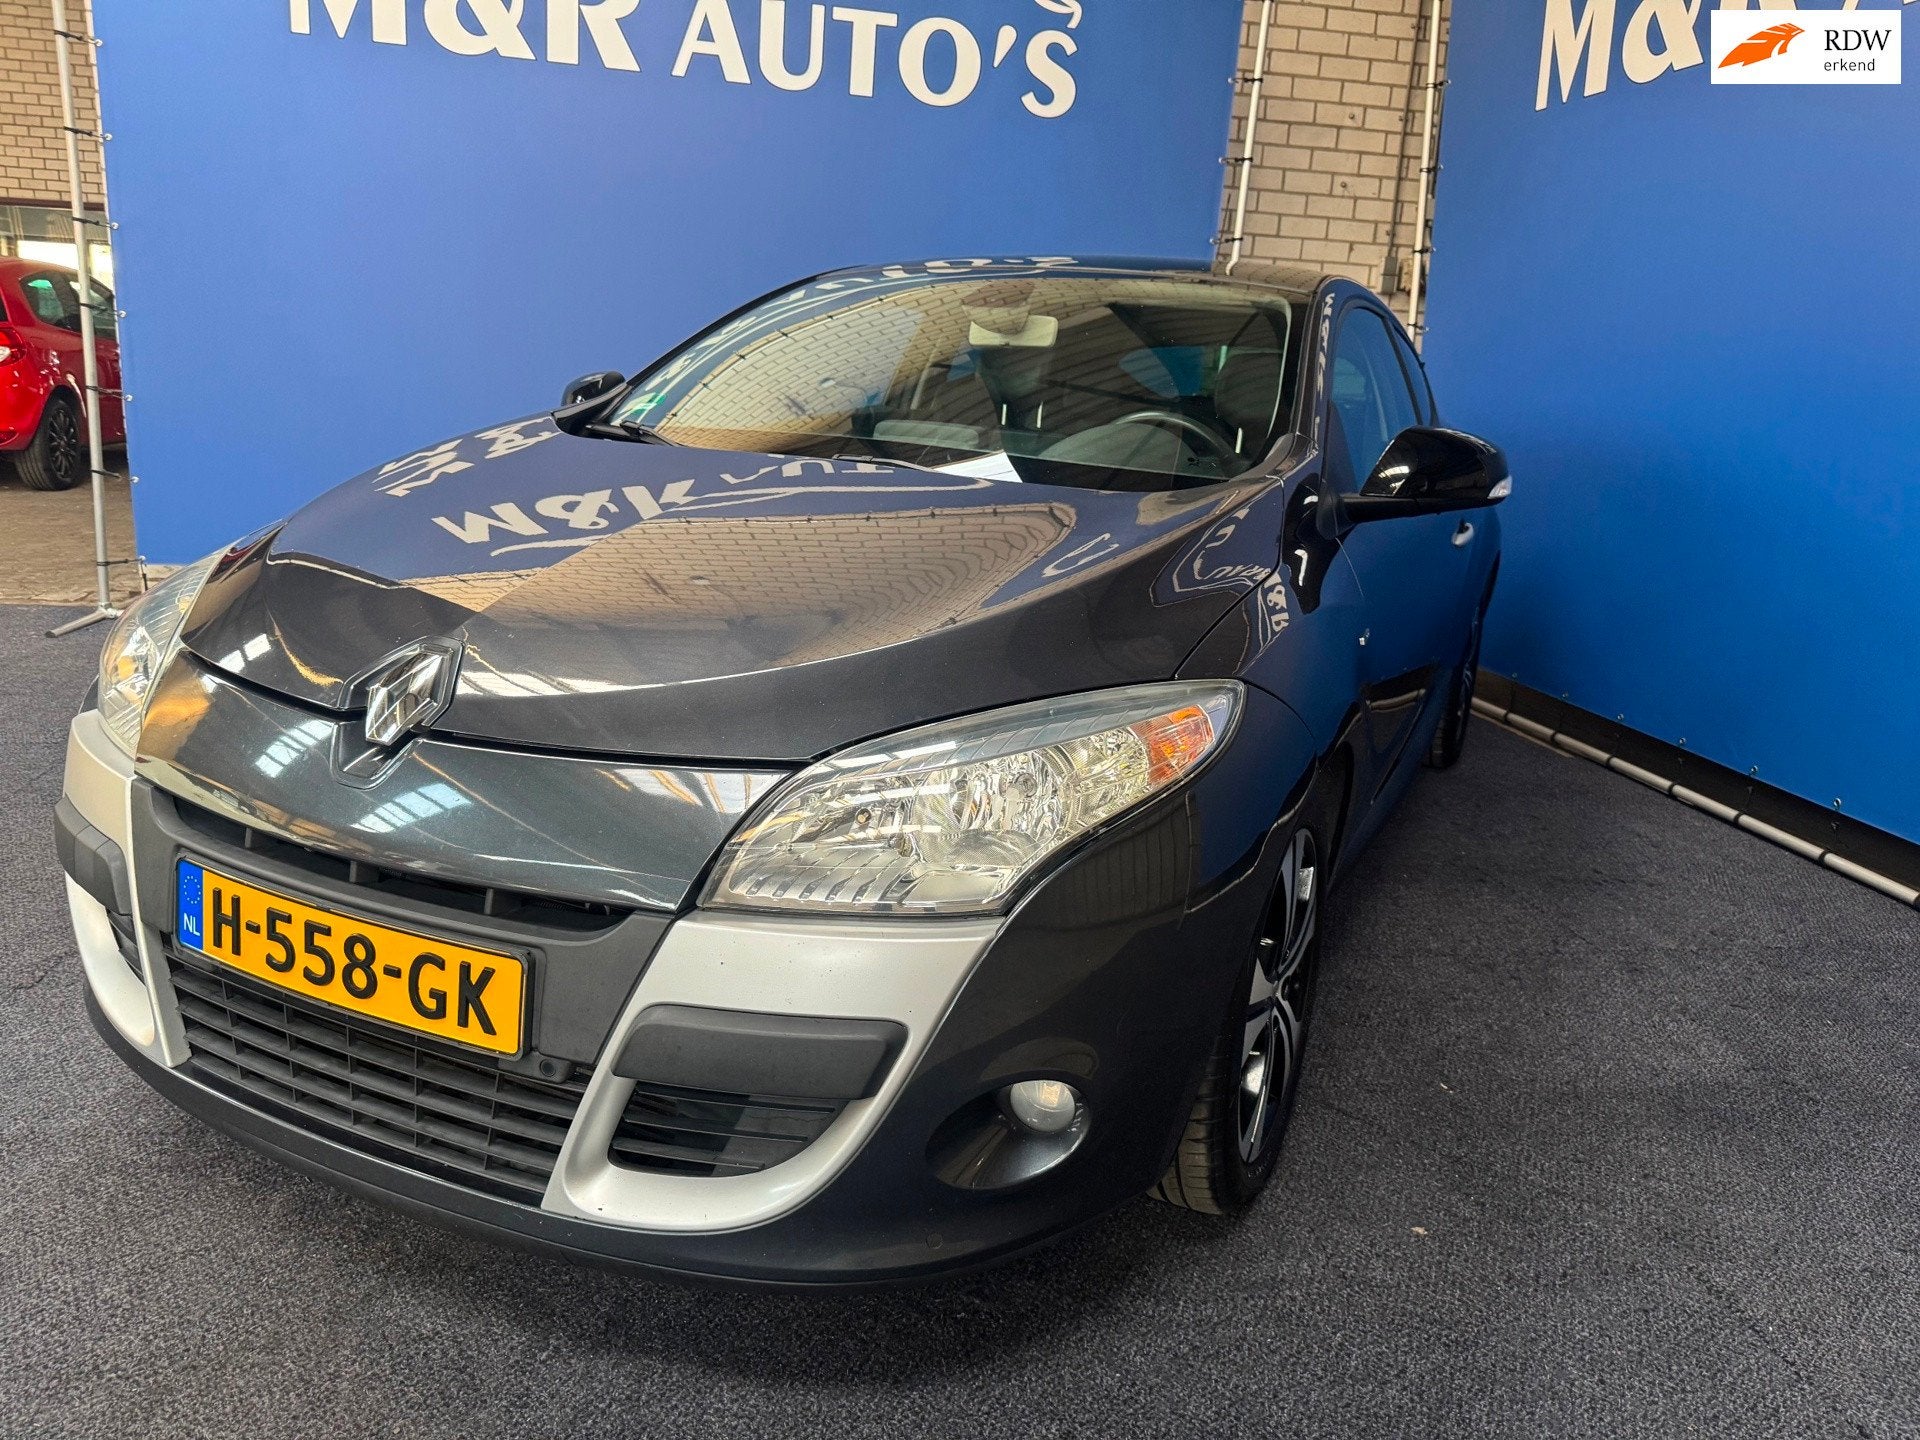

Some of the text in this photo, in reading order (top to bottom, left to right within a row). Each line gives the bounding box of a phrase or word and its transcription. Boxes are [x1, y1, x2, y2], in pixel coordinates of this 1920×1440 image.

[1535, 0, 1797, 111] M&
[183, 912, 201, 937] NL
[212, 887, 497, 1035] H-558-GK
